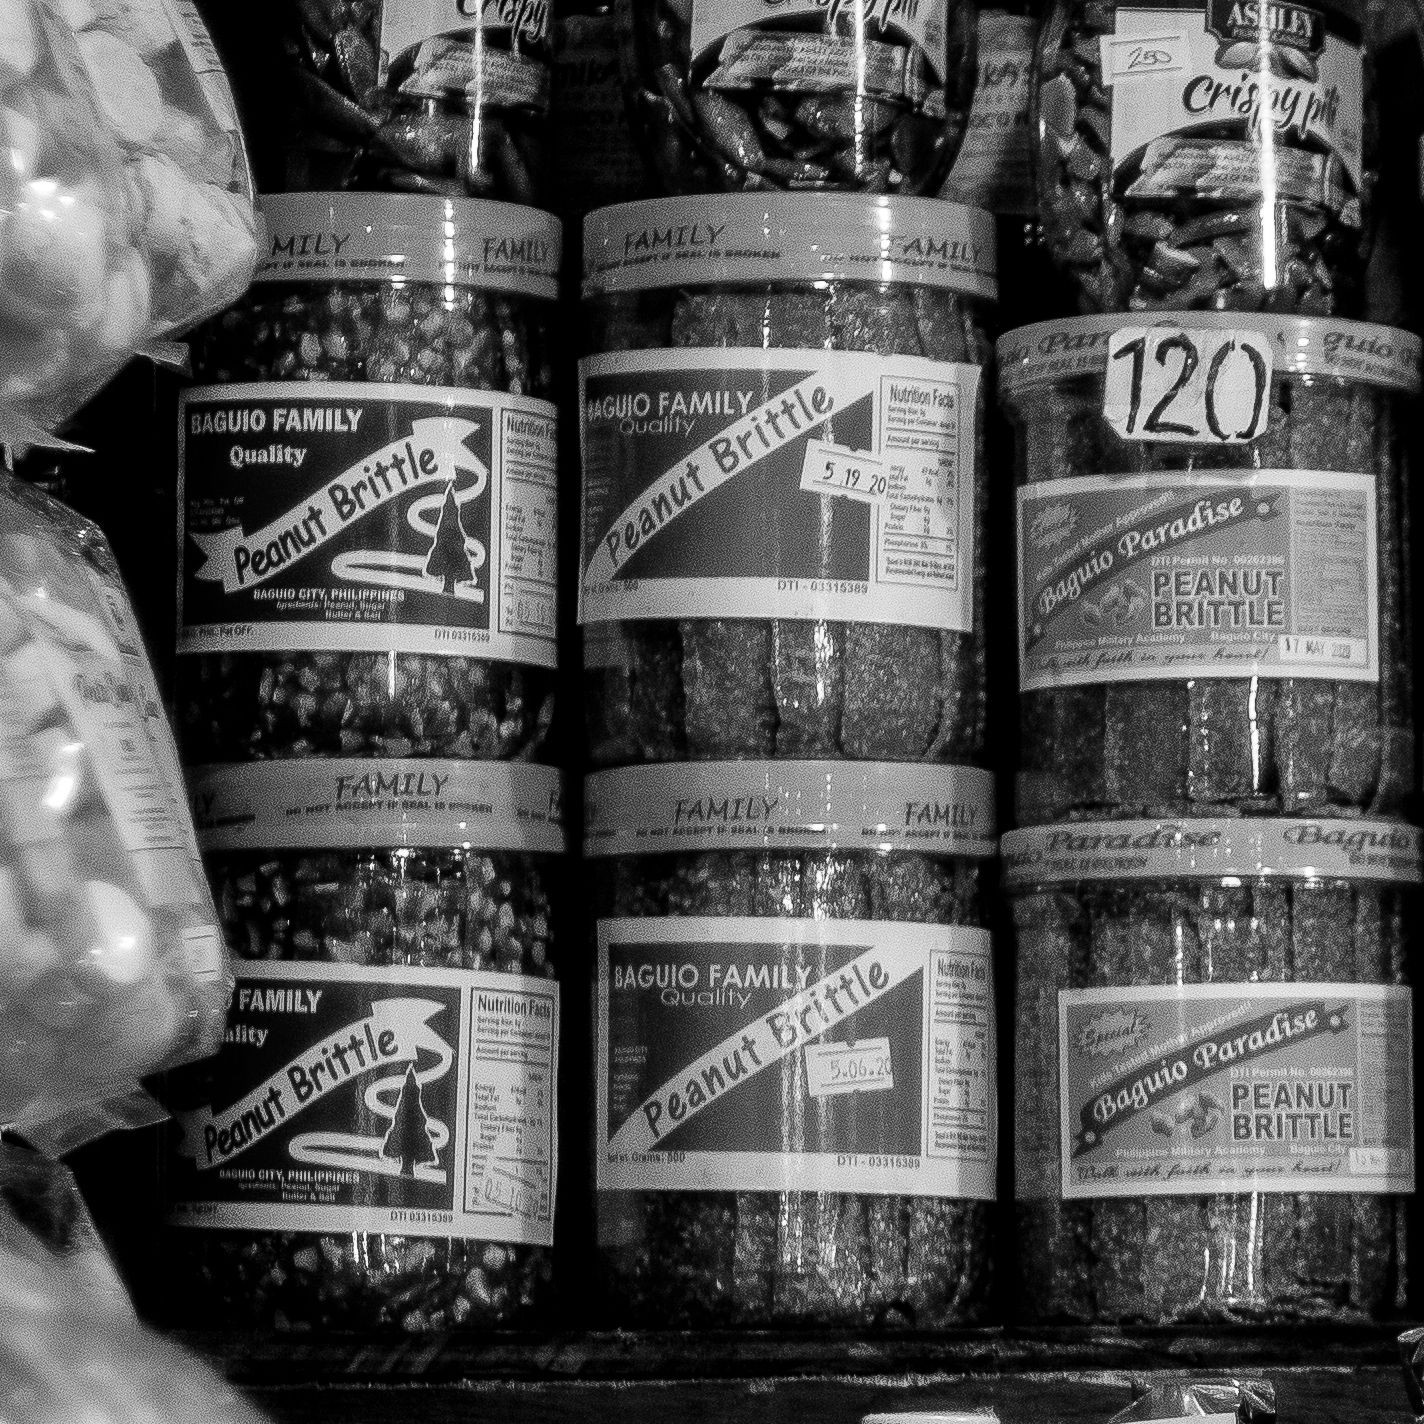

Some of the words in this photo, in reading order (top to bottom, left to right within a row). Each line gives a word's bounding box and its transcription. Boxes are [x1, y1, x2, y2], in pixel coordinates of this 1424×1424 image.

[623, 224, 725, 255] FAMILY
[1112, 331, 1268, 441] 120
[191, 408, 268, 435] BAGUIO
[272, 407, 364, 433] FAMILY
[619, 416, 697, 438] Quality
[229, 445, 308, 469] Quality
[604, 461, 706, 570] Peanut
[708, 385, 836, 476] Brittle
[233, 505, 329, 586] Peanut
[326, 440, 439, 524] Brittle
[1150, 569, 1285, 598] PEANUT
[1151, 600, 1285, 630] BRITTLE
[203, 1098, 284, 1160] Peanut
[289, 1023, 400, 1101] Brittle
[1231, 1082, 1353, 1110] PEANUT
[1232, 1112, 1353, 1140] BRITTLE
